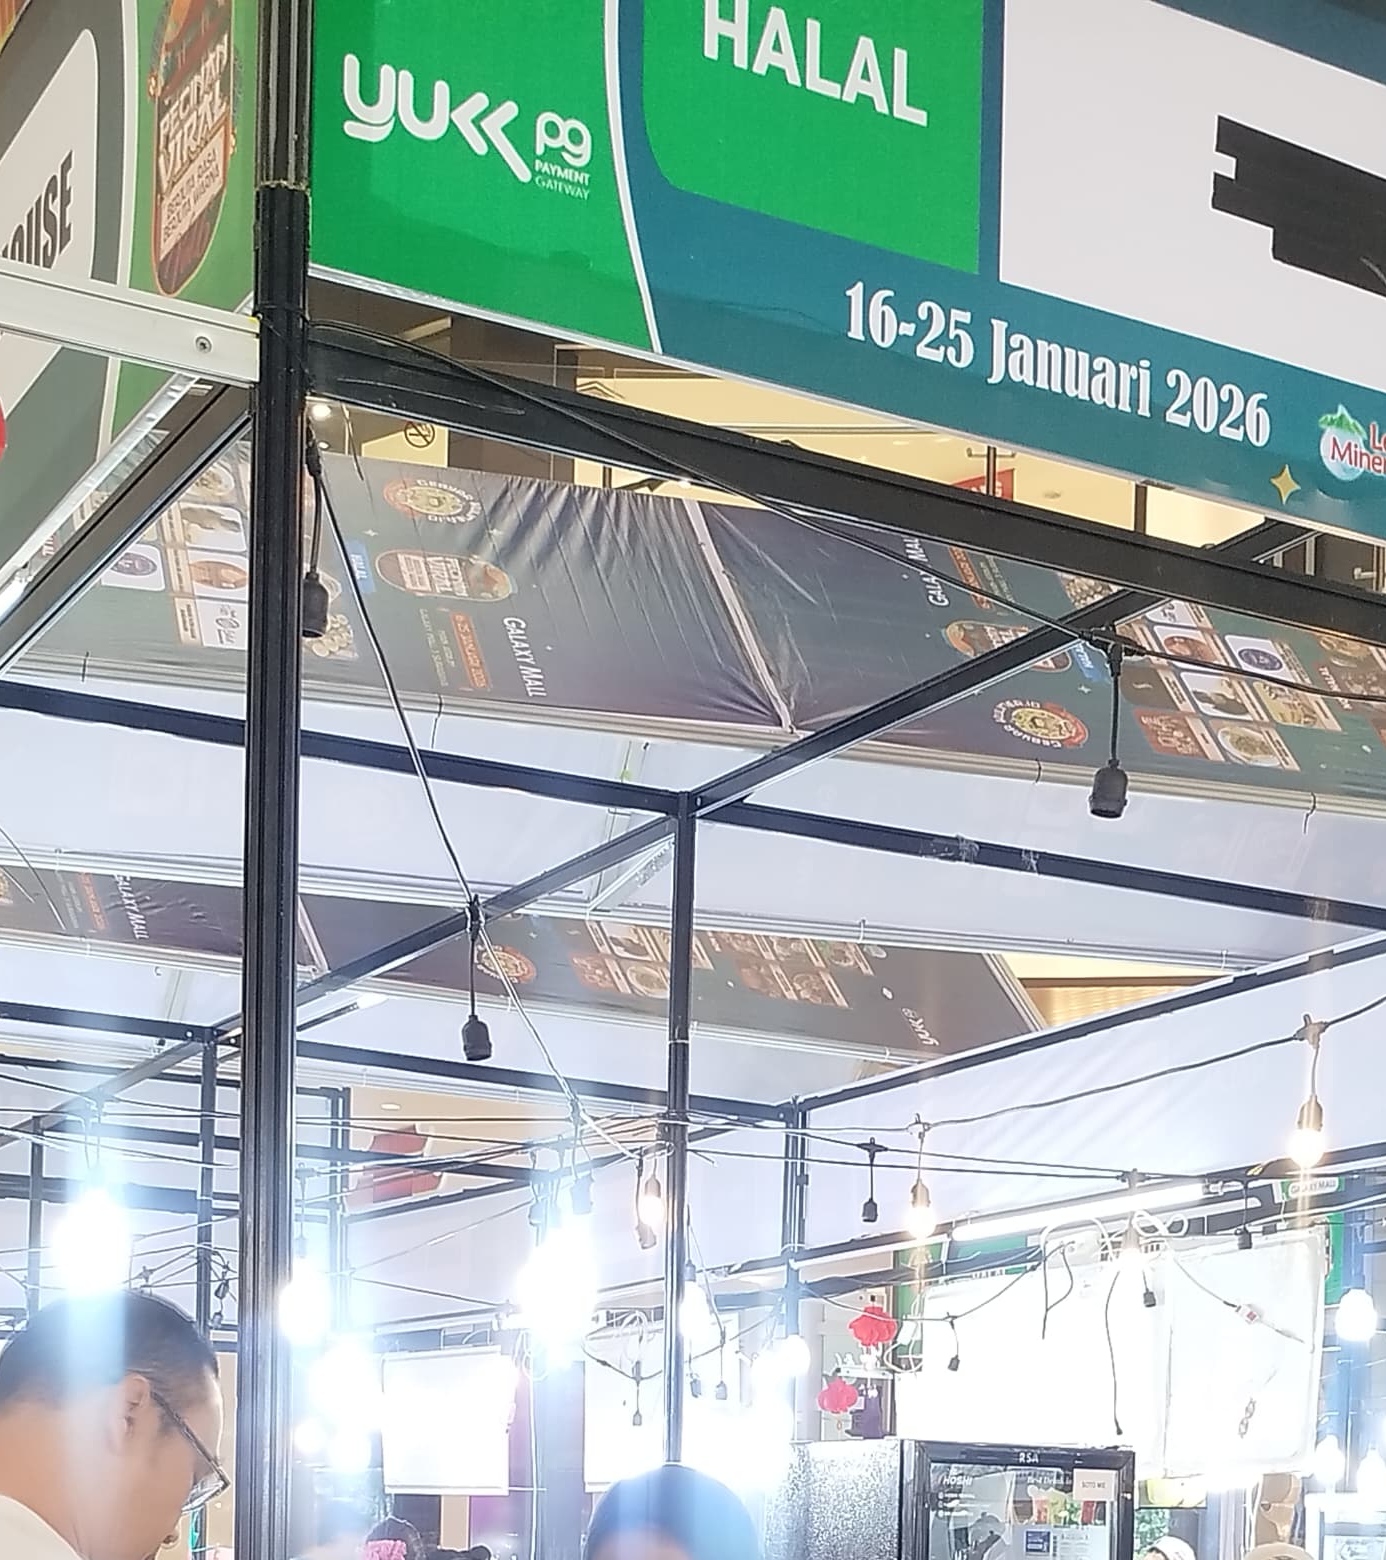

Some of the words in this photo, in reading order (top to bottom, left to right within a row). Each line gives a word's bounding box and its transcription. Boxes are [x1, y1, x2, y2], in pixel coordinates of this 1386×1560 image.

[703, 0, 929, 127] HALAL
[535, 158, 591, 187] PAYMENT
[535, 174, 591, 201] GATEWAY
[846, 280, 976, 369] 16-25
[987, 316, 1153, 420] Januari
[1163, 366, 1272, 450] 2026
[502, 615, 534, 665] GALAXY
[517, 659, 547, 698] MALL
[1019, 1452, 1040, 1464] RSA
[941, 1474, 973, 1487] HOSHI
